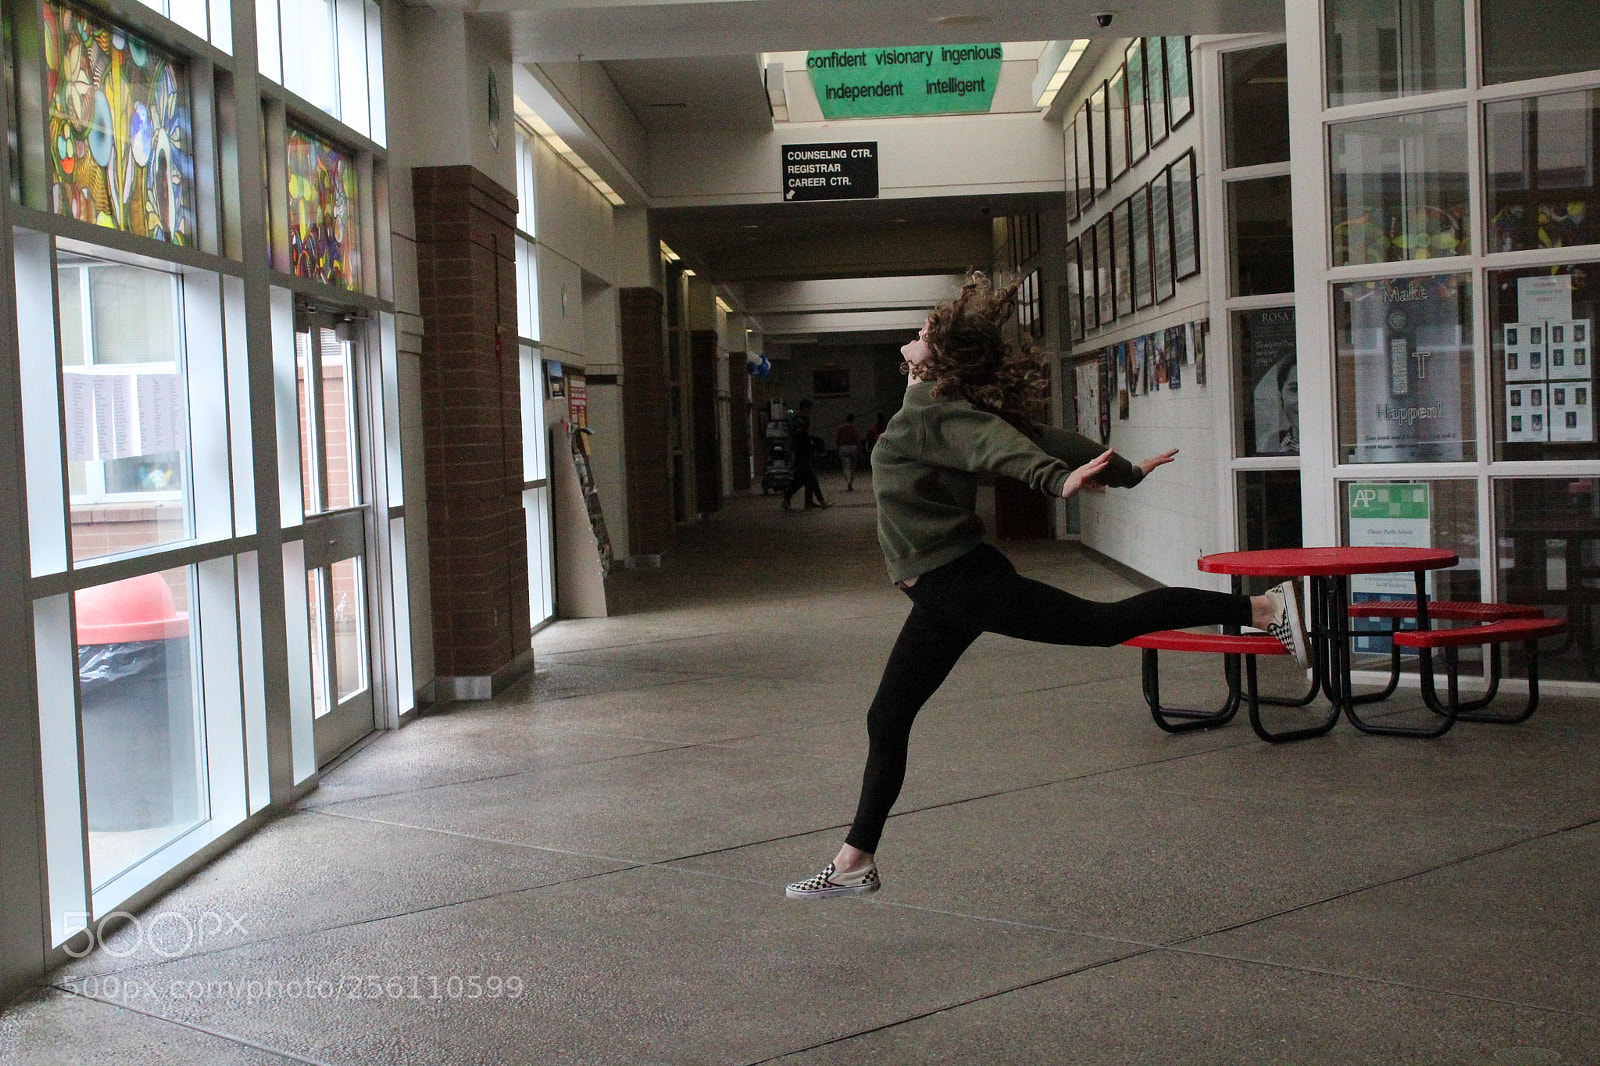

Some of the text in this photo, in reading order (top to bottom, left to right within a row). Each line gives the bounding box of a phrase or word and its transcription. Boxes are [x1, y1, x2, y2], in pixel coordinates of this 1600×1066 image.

[807, 45, 1001, 69] confident visionary ingenious
[825, 76, 986, 101] independent intelligent
[787, 149, 873, 161] COUNSELING CTR.
[788, 164, 841, 174] REGISTRAR
[788, 176, 852, 187] CAREER CTR.
[1383, 285, 1428, 303] Make
[1262, 312, 1289, 322] ROSA
[1376, 402, 1442, 426] Happen!
[1352, 489, 1376, 508] AP
